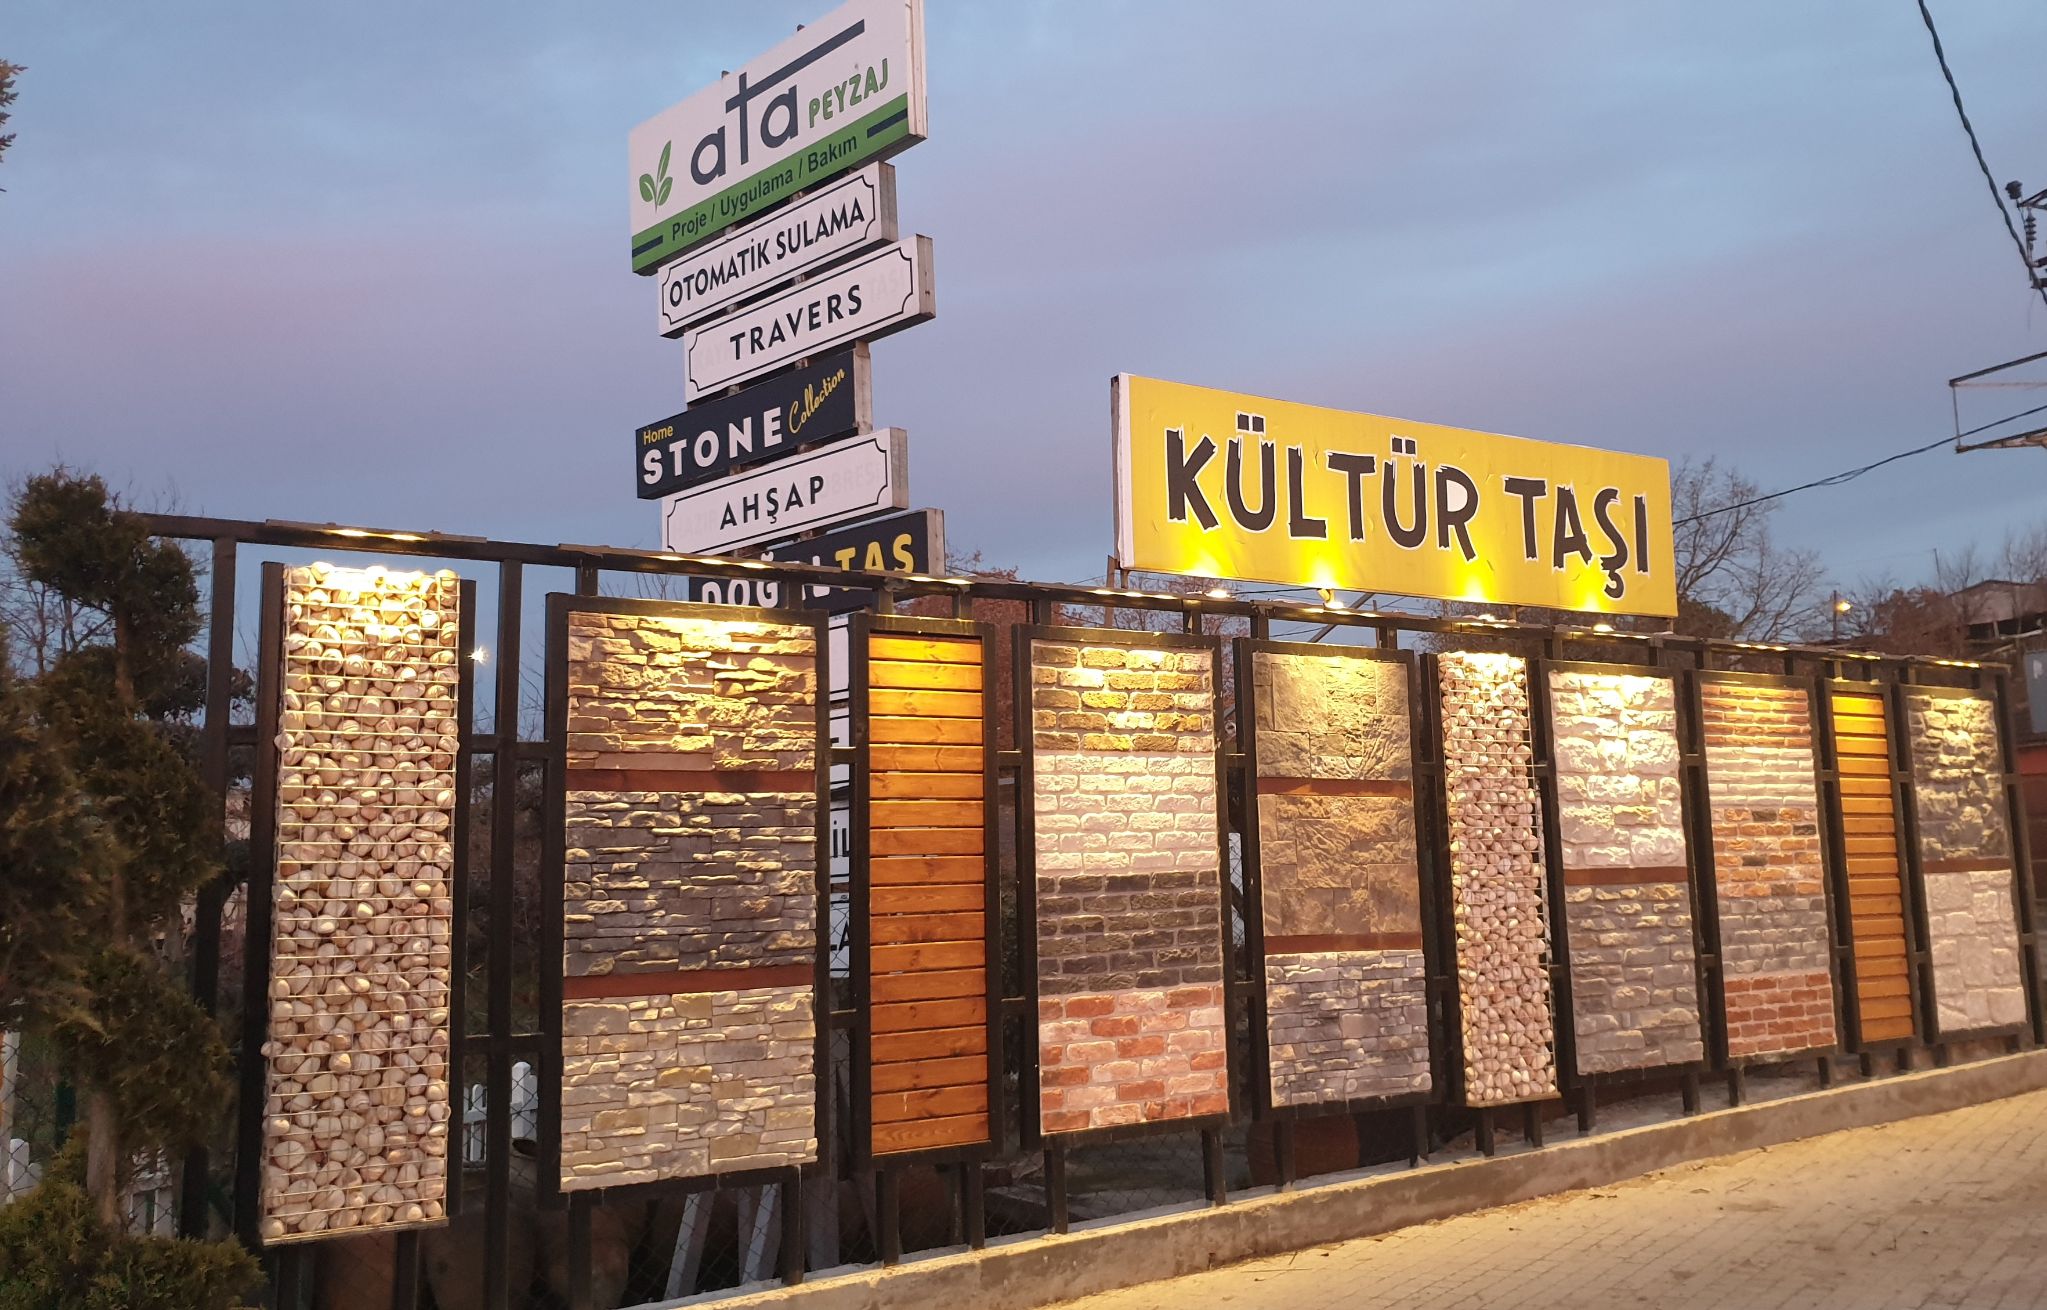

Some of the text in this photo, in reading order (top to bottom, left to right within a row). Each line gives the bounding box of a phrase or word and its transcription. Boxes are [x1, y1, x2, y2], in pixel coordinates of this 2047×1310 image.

[690, 58, 889, 186] ata PEYZAJ
[672, 212, 707, 241] Proje
[720, 173, 794, 219] Uygulama
[808, 134, 857, 173] Bakım
[669, 197, 865, 308] OTOMATİK SULAMA
[730, 285, 862, 360] TRAVERS
[643, 406, 783, 485] STONE
[789, 368, 845, 434] Collection
[643, 424, 674, 446] Home
[720, 475, 825, 531] AHŞAP
[1165, 412, 1649, 599] KÜLTÜR TAŞI
